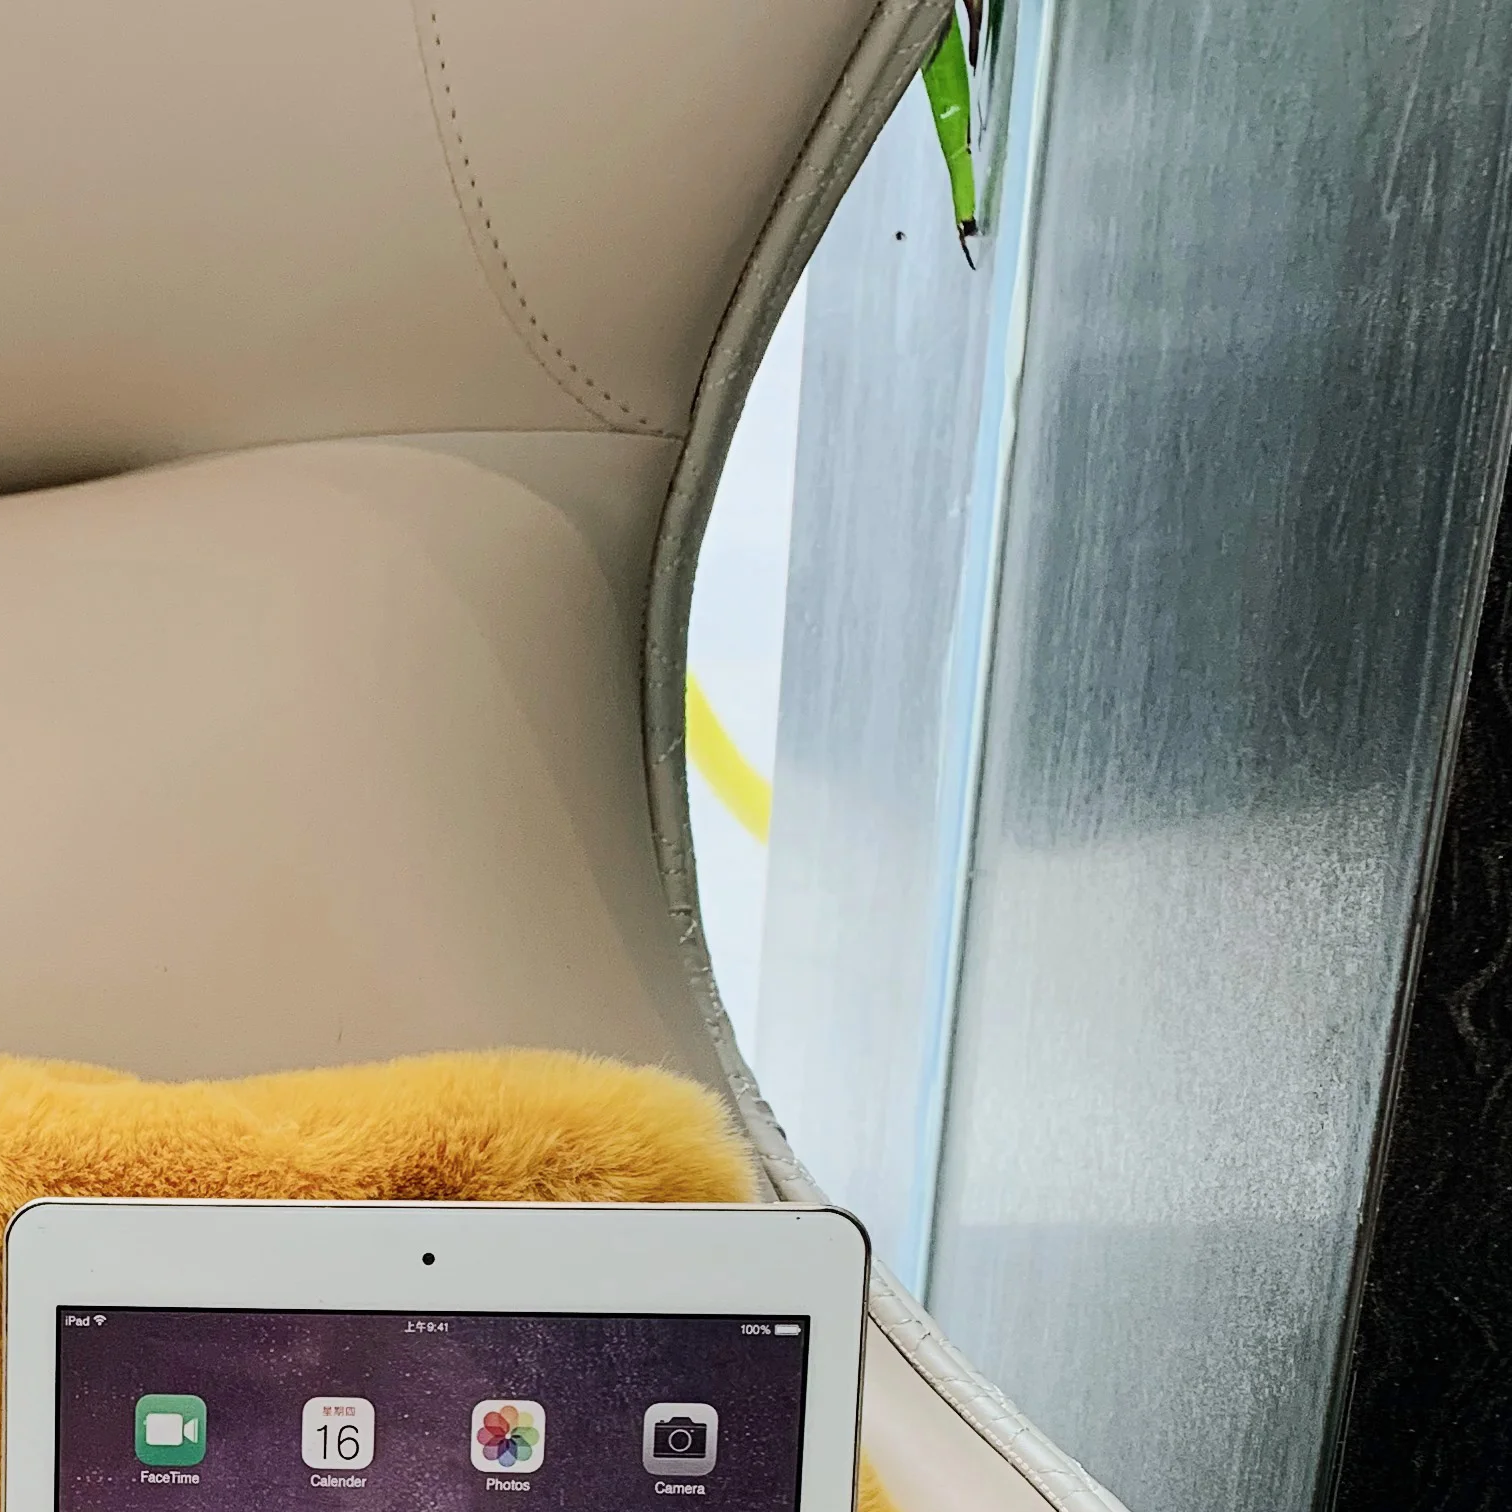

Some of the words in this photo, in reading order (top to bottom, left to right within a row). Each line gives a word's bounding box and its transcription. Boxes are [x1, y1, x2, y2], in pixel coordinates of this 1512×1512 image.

[65, 1315, 90, 1327] iPad
[741, 1324, 771, 1336] 100%
[322, 1406, 356, 1417] 星期四
[317, 1424, 360, 1461] 16
[140, 1470, 200, 1485] FaceTime
[310, 1473, 368, 1488] Calender
[486, 1478, 531, 1492] Photos
[654, 1481, 706, 1496] Camera
